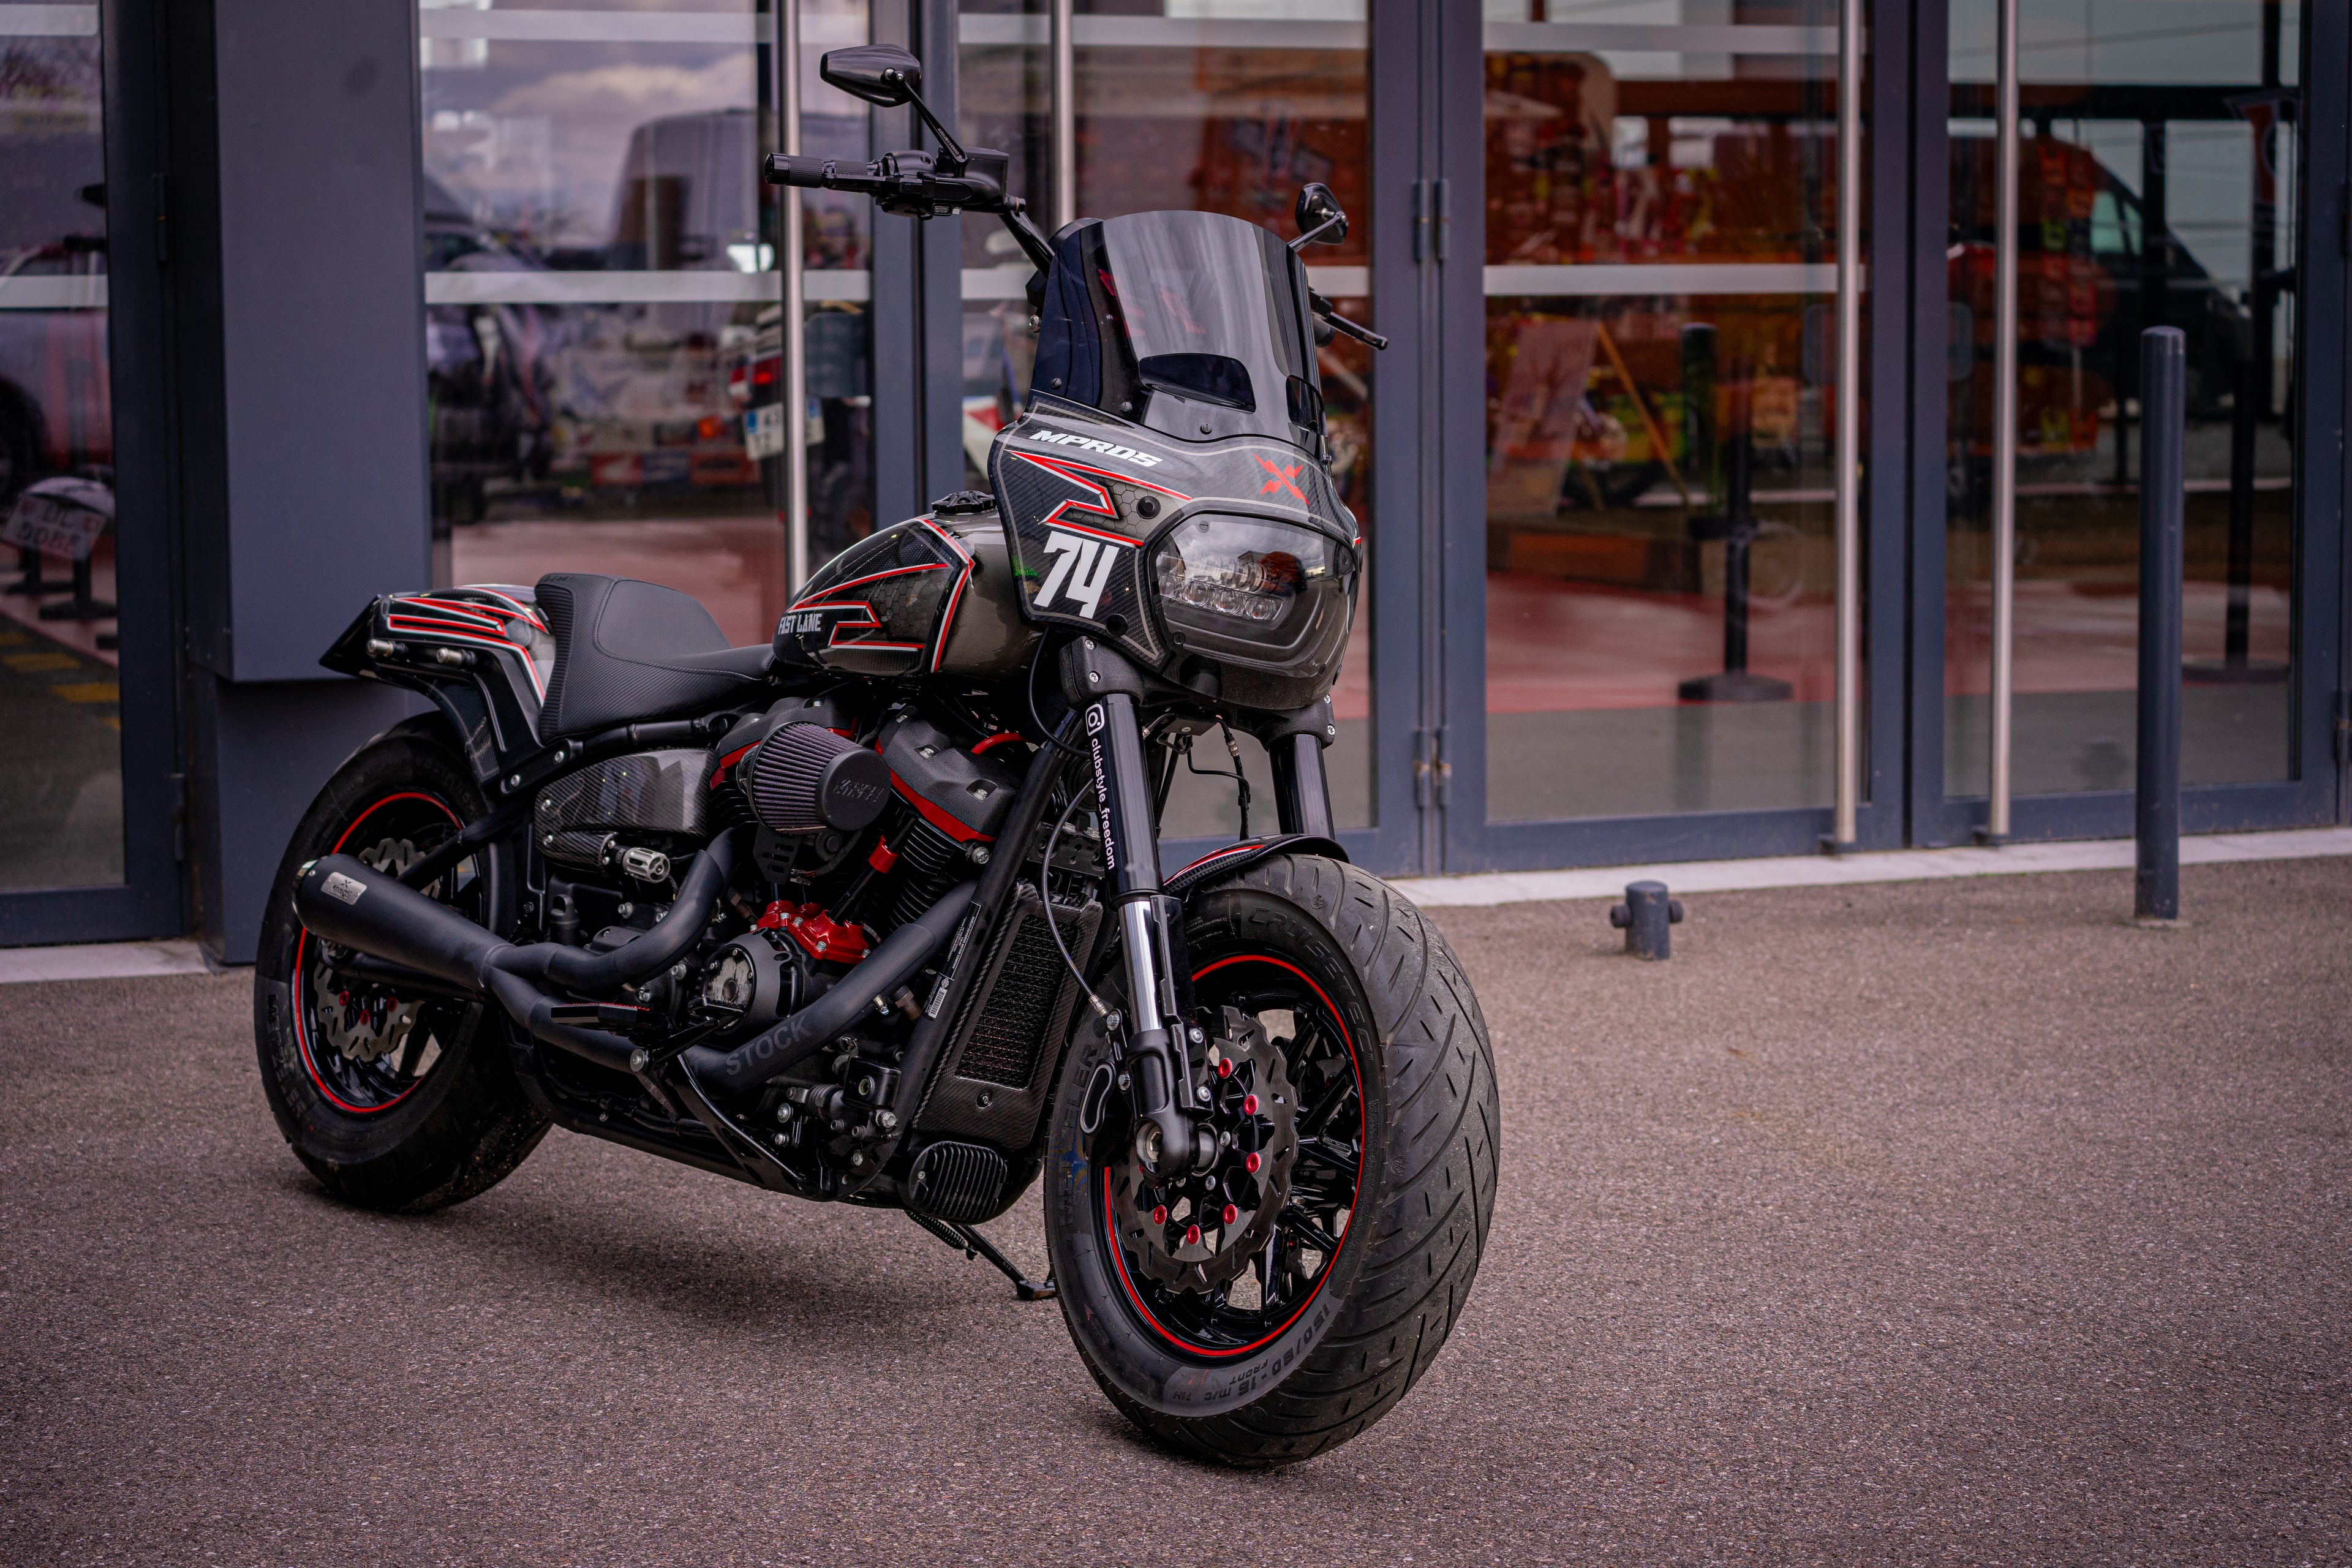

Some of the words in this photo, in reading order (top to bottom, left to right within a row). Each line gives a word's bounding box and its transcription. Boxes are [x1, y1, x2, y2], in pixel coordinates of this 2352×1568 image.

[1029, 430, 1163, 467] MPROS
[1033, 530, 1120, 619] 74
[778, 615, 796, 635] FAST
[797, 613, 823, 633] LANE
[1091, 737, 1115, 870] clubstyle_freedom
[725, 1014, 812, 1076] STOCK
